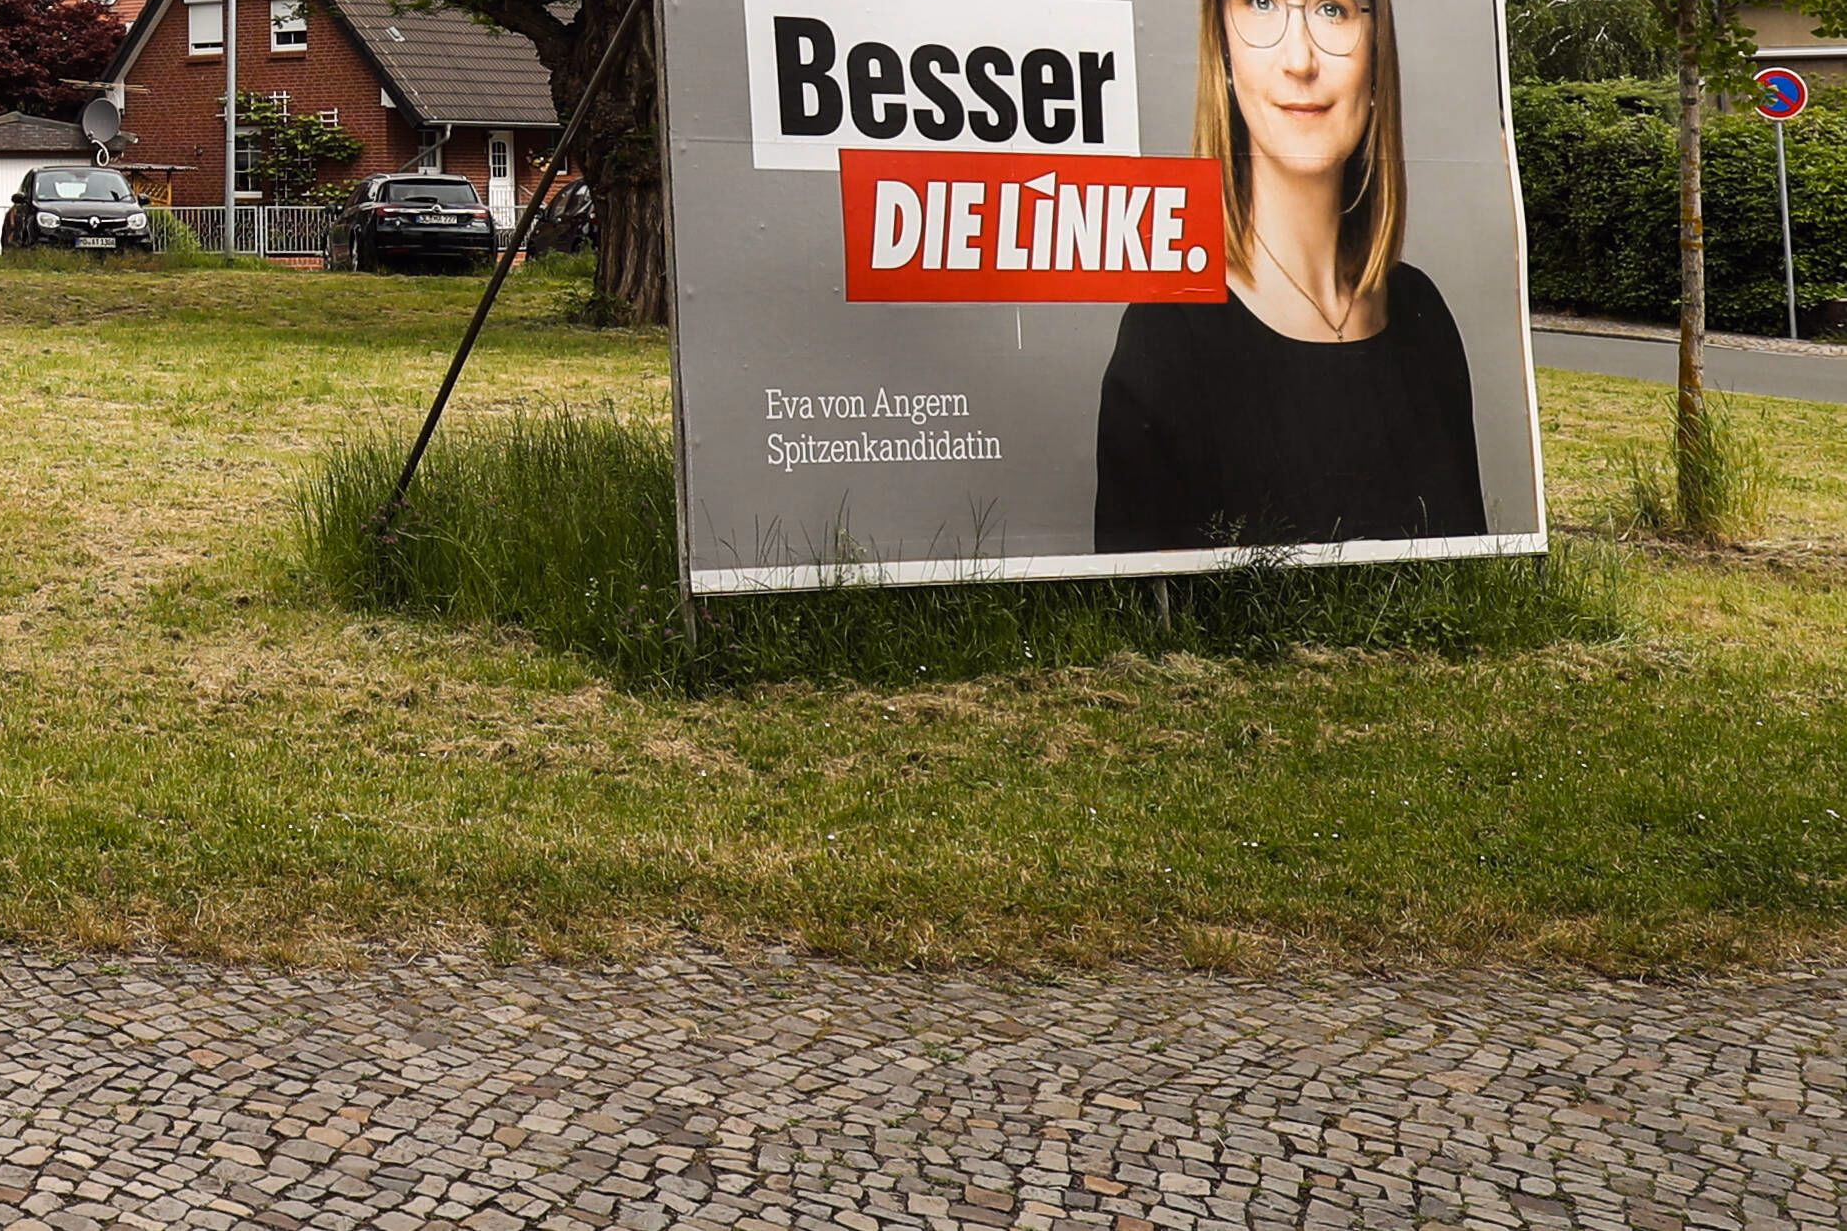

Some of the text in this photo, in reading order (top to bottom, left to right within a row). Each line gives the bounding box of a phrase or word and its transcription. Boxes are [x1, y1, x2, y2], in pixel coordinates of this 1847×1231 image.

[773, 15, 1115, 144] Besser
[871, 179, 986, 270] DIE
[765, 386, 970, 426] Eva von Angern
[767, 429, 1003, 472] Spitzenkandidatin
